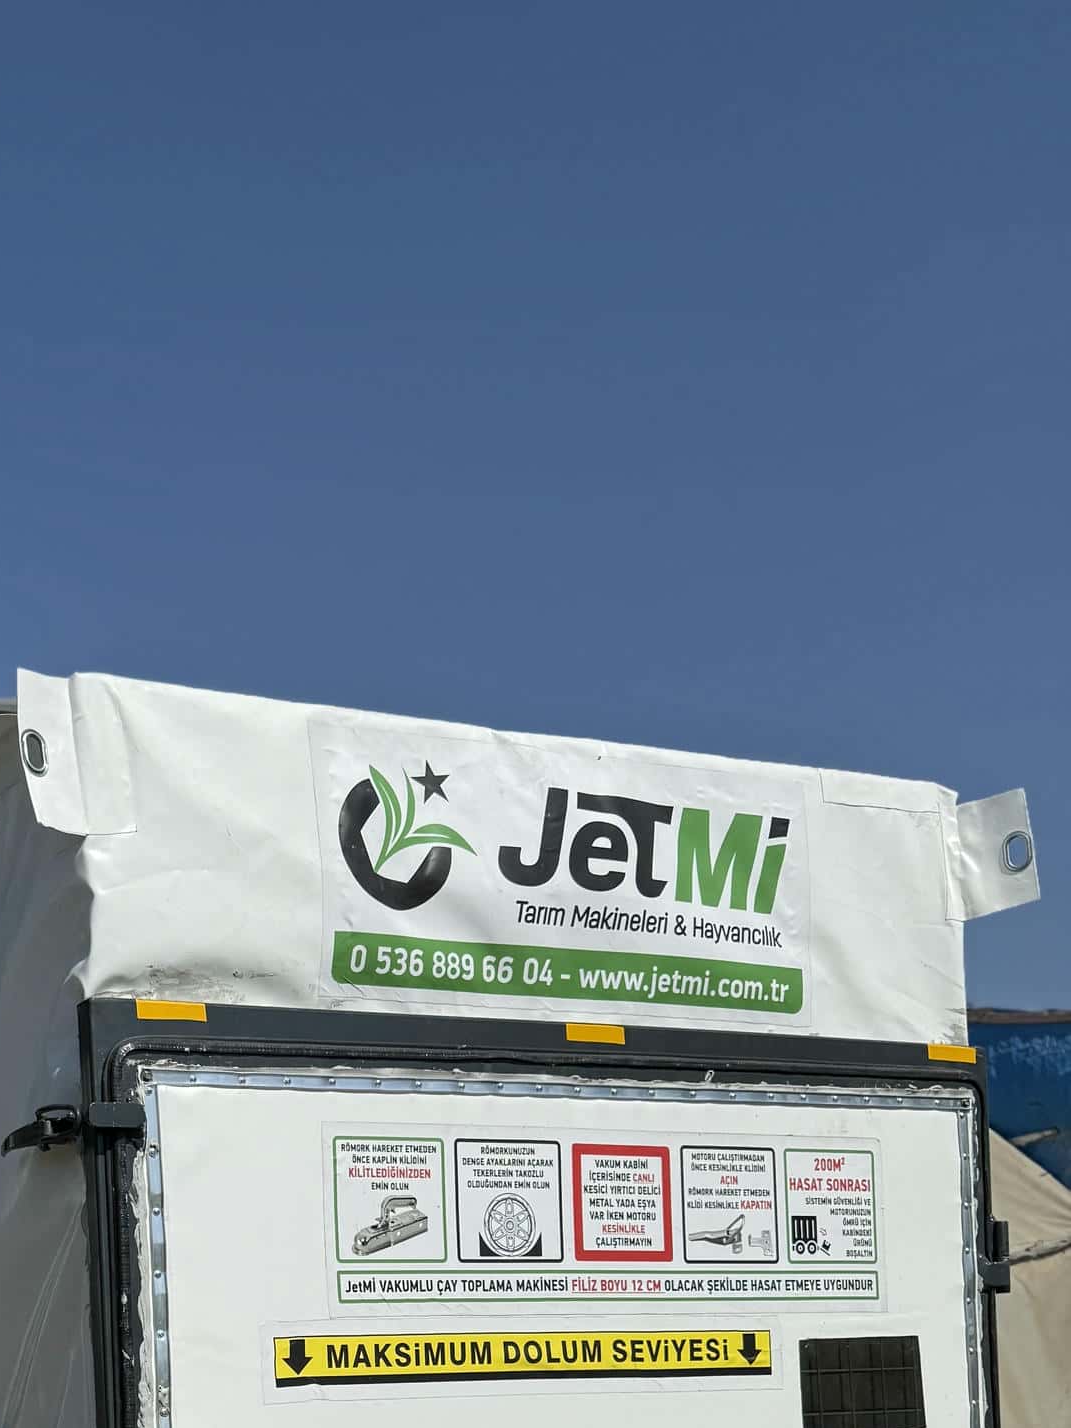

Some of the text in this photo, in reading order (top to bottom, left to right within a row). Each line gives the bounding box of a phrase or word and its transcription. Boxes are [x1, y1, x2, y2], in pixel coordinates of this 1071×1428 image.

[515, 901, 783, 949] Tarım Makineleri & Hayvancılık
[350, 945, 366, 973] 0
[376, 947, 424, 977] 536
[432, 952, 475, 981] 889
[482, 956, 514, 984] 66
[523, 958, 553, 986] 04
[579, 966, 790, 1004] www.jetmi.com.tr
[341, 1143, 437, 1153] RÖMORK HAREKET ETMEDEN
[480, 1145, 535, 1155] RÖMORKUNUZUN
[352, 1154, 370, 1164] ÖNCE
[372, 1154, 397, 1164] KAPLİN
[486, 1158, 525, 1166] AYAKLARINI
[527, 1159, 554, 1168] AÇARAK
[594, 1158, 648, 1169] VAKUM KABİNİ
[348, 1165, 431, 1179] KİLİTLEDİĞİNİZDEN
[473, 1168, 544, 1177] TEKERLERİN TAKOZLU
[589, 1170, 655, 1183] İÇERİSİNDE CANLI
[371, 1181, 409, 1190] EMİN OLUN
[467, 1179, 550, 1189] OLDUĞUNDAN EMİN OLUN
[720, 1175, 738, 1187] AÇIN
[789, 1177, 871, 1192] HASAT SONRASI
[583, 1184, 661, 1195] KESİCİ YIRTICI DELİCİ
[688, 1187, 770, 1197] RÖMORK HAREKET ETMEDEN
[589, 1198, 656, 1210] METAL YADA EŞYA
[740, 1200, 772, 1210] KAPATIN
[589, 1210, 656, 1221] VAR İKEN MOTORU
[602, 1223, 646, 1233] KESİNLİKLE
[595, 1237, 652, 1248] ÇALIŞTIRMAYIN
[379, 1279, 433, 1293] VAKUMLU
[437, 1280, 458, 1295] ÇAY
[461, 1279, 512, 1292] TOPLAMA
[516, 1276, 569, 1292] MAKİNESİ
[572, 1276, 598, 1291] FİLİZ
[600, 1279, 627, 1291] BOYU
[632, 1279, 643, 1291] 12
[646, 1279, 661, 1291] CM
[664, 1279, 704, 1292] OLACAK
[707, 1276, 748, 1295] ŞEKİLDE
[750, 1279, 782, 1292] HASAT
[785, 1279, 821, 1291] ETMEYE
[823, 1279, 873, 1291] UYGUNDUR
[503, 1341, 602, 1365] DOLUM
